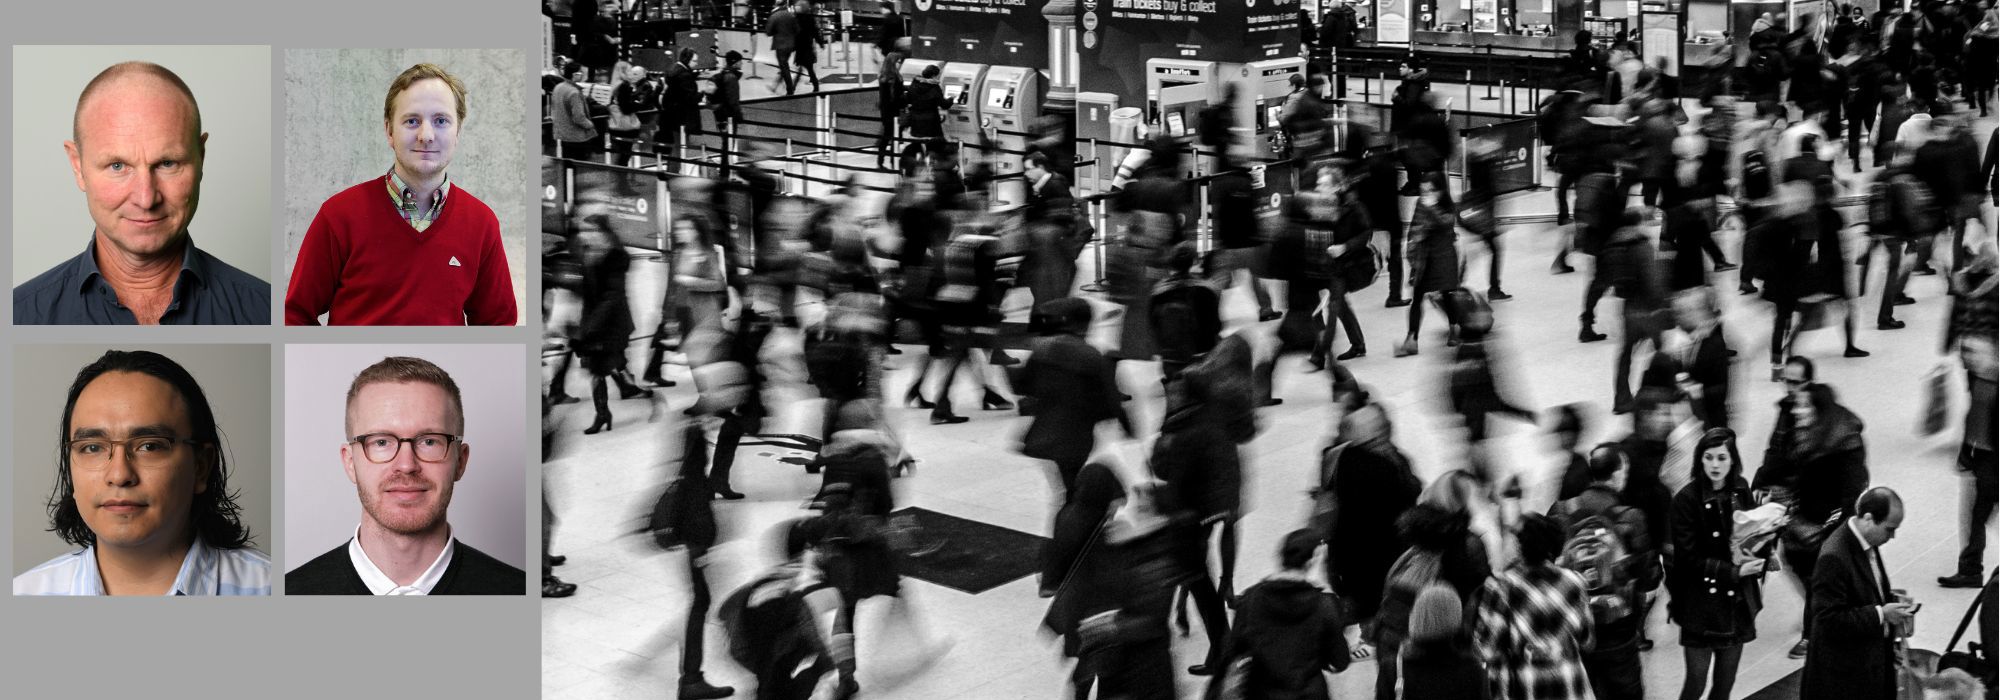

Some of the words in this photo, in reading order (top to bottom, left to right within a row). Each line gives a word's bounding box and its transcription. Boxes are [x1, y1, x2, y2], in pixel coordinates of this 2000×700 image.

[1133, 0, 1162, 10] tickets
[1163, 0, 1178, 13] buy
[1189, 0, 1216, 12] collect
